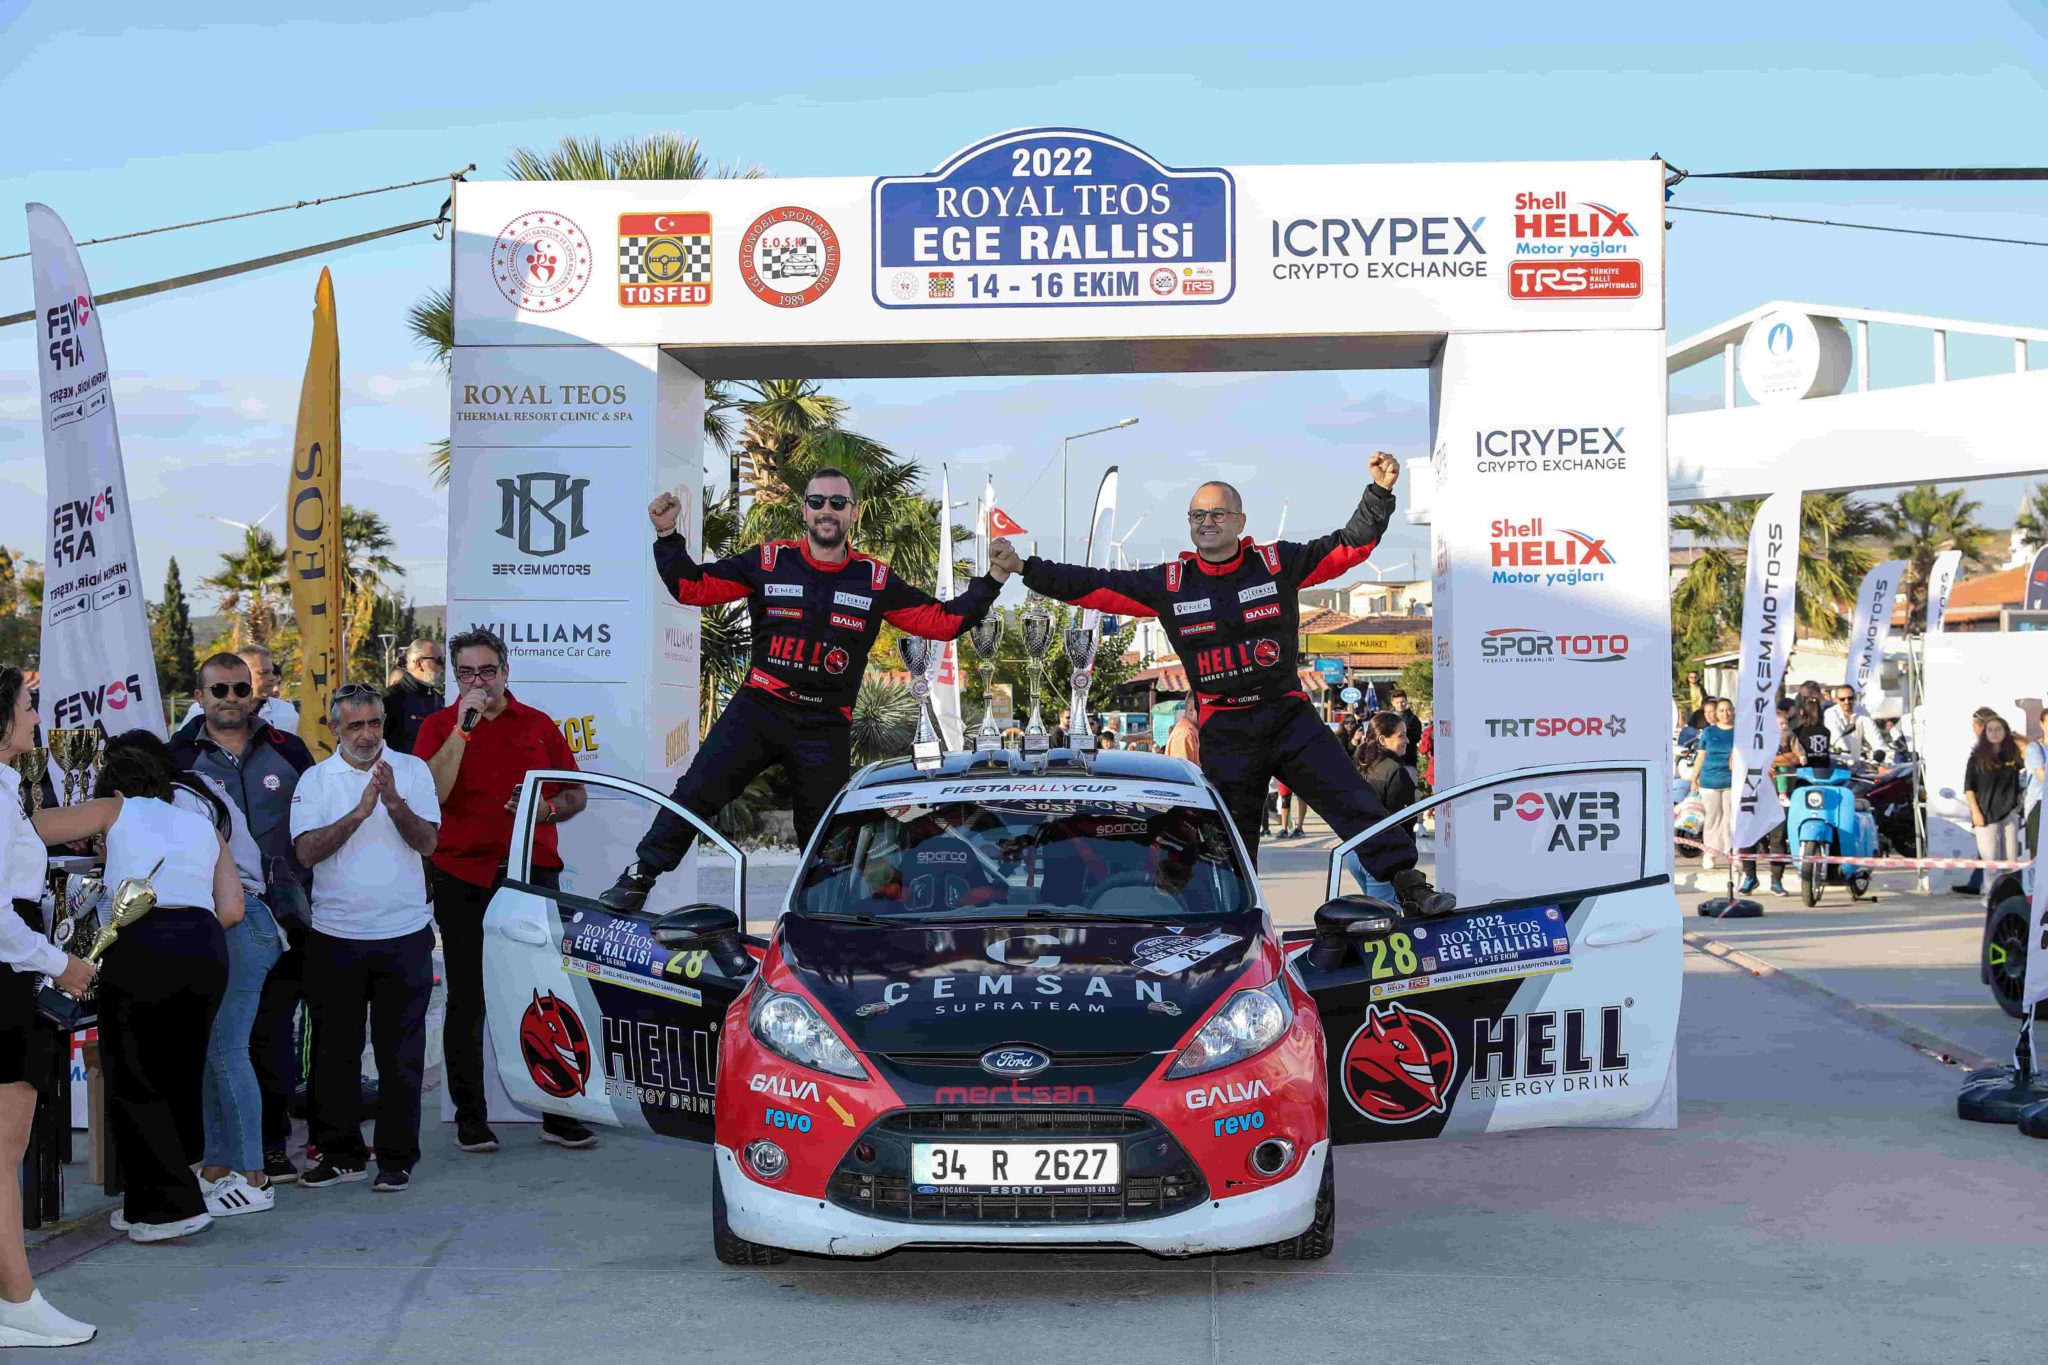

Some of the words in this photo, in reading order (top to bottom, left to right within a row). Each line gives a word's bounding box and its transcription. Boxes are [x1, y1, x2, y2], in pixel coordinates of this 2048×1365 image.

[1012, 147, 1093, 177] 2022
[935, 185, 1064, 218] ROYAL
[1073, 182, 1171, 215] TEOS
[1515, 191, 1567, 211] Shell
[1514, 209, 1637, 238] HELIX
[913, 226, 1001, 262] EGE
[1273, 216, 1487, 258] ICRYPEX
[1515, 243, 1564, 255] Motor
[1569, 239, 1627, 258] yağları
[1273, 263, 1359, 281] CRYPTO
[1367, 261, 1488, 279] EXCHANGE
[1514, 267, 1588, 293] TRS
[1590, 267, 1620, 275] TÜRKİYE
[748, 272, 765, 293] EGE
[967, 273, 999, 298] 14
[1031, 272, 1063, 297] 16
[624, 285, 707, 304] TOSFED
[779, 294, 804, 305] 1989
[463, 384, 553, 405] ROYAL
[559, 384, 627, 405] TEOS
[456, 412, 512, 421] THERMAL
[514, 412, 558, 421] RESORT
[560, 412, 600, 421] CLINIC
[602, 412, 610, 421] &
[613, 412, 633, 421] SPA
[1476, 427, 1626, 457] ICRYPEX
[1477, 460, 1537, 473] CRYPTO
[1543, 457, 1626, 472] EXCHANGE
[1491, 517, 1542, 538] Shell
[1489, 538, 1615, 567] HELIX
[492, 564, 541, 575] BERKEM
[542, 564, 591, 575] MOTORS
[1492, 570, 1541, 584] Motor
[1546, 568, 1604, 586] yağları
[1760, 523, 1783, 635] MOTORS
[774, 587, 802, 595] EMEK
[1183, 602, 1209, 612] EMEK
[1245, 607, 1280, 620] GALVA
[1864, 579, 1888, 652] MOTORS
[832, 616, 863, 629] GALVA
[505, 646, 564, 657] erformance
[566, 646, 585, 657] Car
[587, 647, 612, 657] Care
[1493, 791, 1620, 821] POWER
[1096, 823, 1148, 835] sparco
[1547, 824, 1620, 852] APP
[917, 851, 968, 862] sparco
[608, 918, 638, 933] 2022
[1440, 927, 1496, 946] ROYAL
[1497, 920, 1541, 936] TEOS
[1466, 915, 1505, 930] 2022
[575, 935, 600, 953] EGE
[583, 923, 621, 945] ROYAL
[624, 932, 654, 950] TEOS
[1178, 949, 1211, 962] 28
[1364, 932, 1418, 980] 28
[1438, 943, 1473, 962] EGE
[665, 949, 709, 979] 28
[1408, 977, 1430, 989] TRS
[1453, 972, 1472, 981] HELIX
[935, 1001, 1105, 1014] SUPRATEAM
[1471, 1005, 1630, 1084] HELL
[601, 1016, 717, 1096] HELL
[996, 1052, 1033, 1068] Ford
[749, 1073, 820, 1103] GALVA
[935, 1078, 1095, 1104] mertsan
[1185, 1079, 1272, 1110] GALVA
[1470, 1079, 1555, 1100] ENERGY
[1564, 1072, 1630, 1093] DRINK
[604, 1081, 666, 1106] ENERGY
[669, 1092, 716, 1115] DRIN
[765, 1107, 812, 1133] revo
[1214, 1110, 1264, 1137] revo
[931, 1149, 967, 1181] 34
[992, 1149, 1009, 1181] R
[1034, 1149, 1108, 1181] 2627
[990, 1186, 1044, 1194] ESOTO
